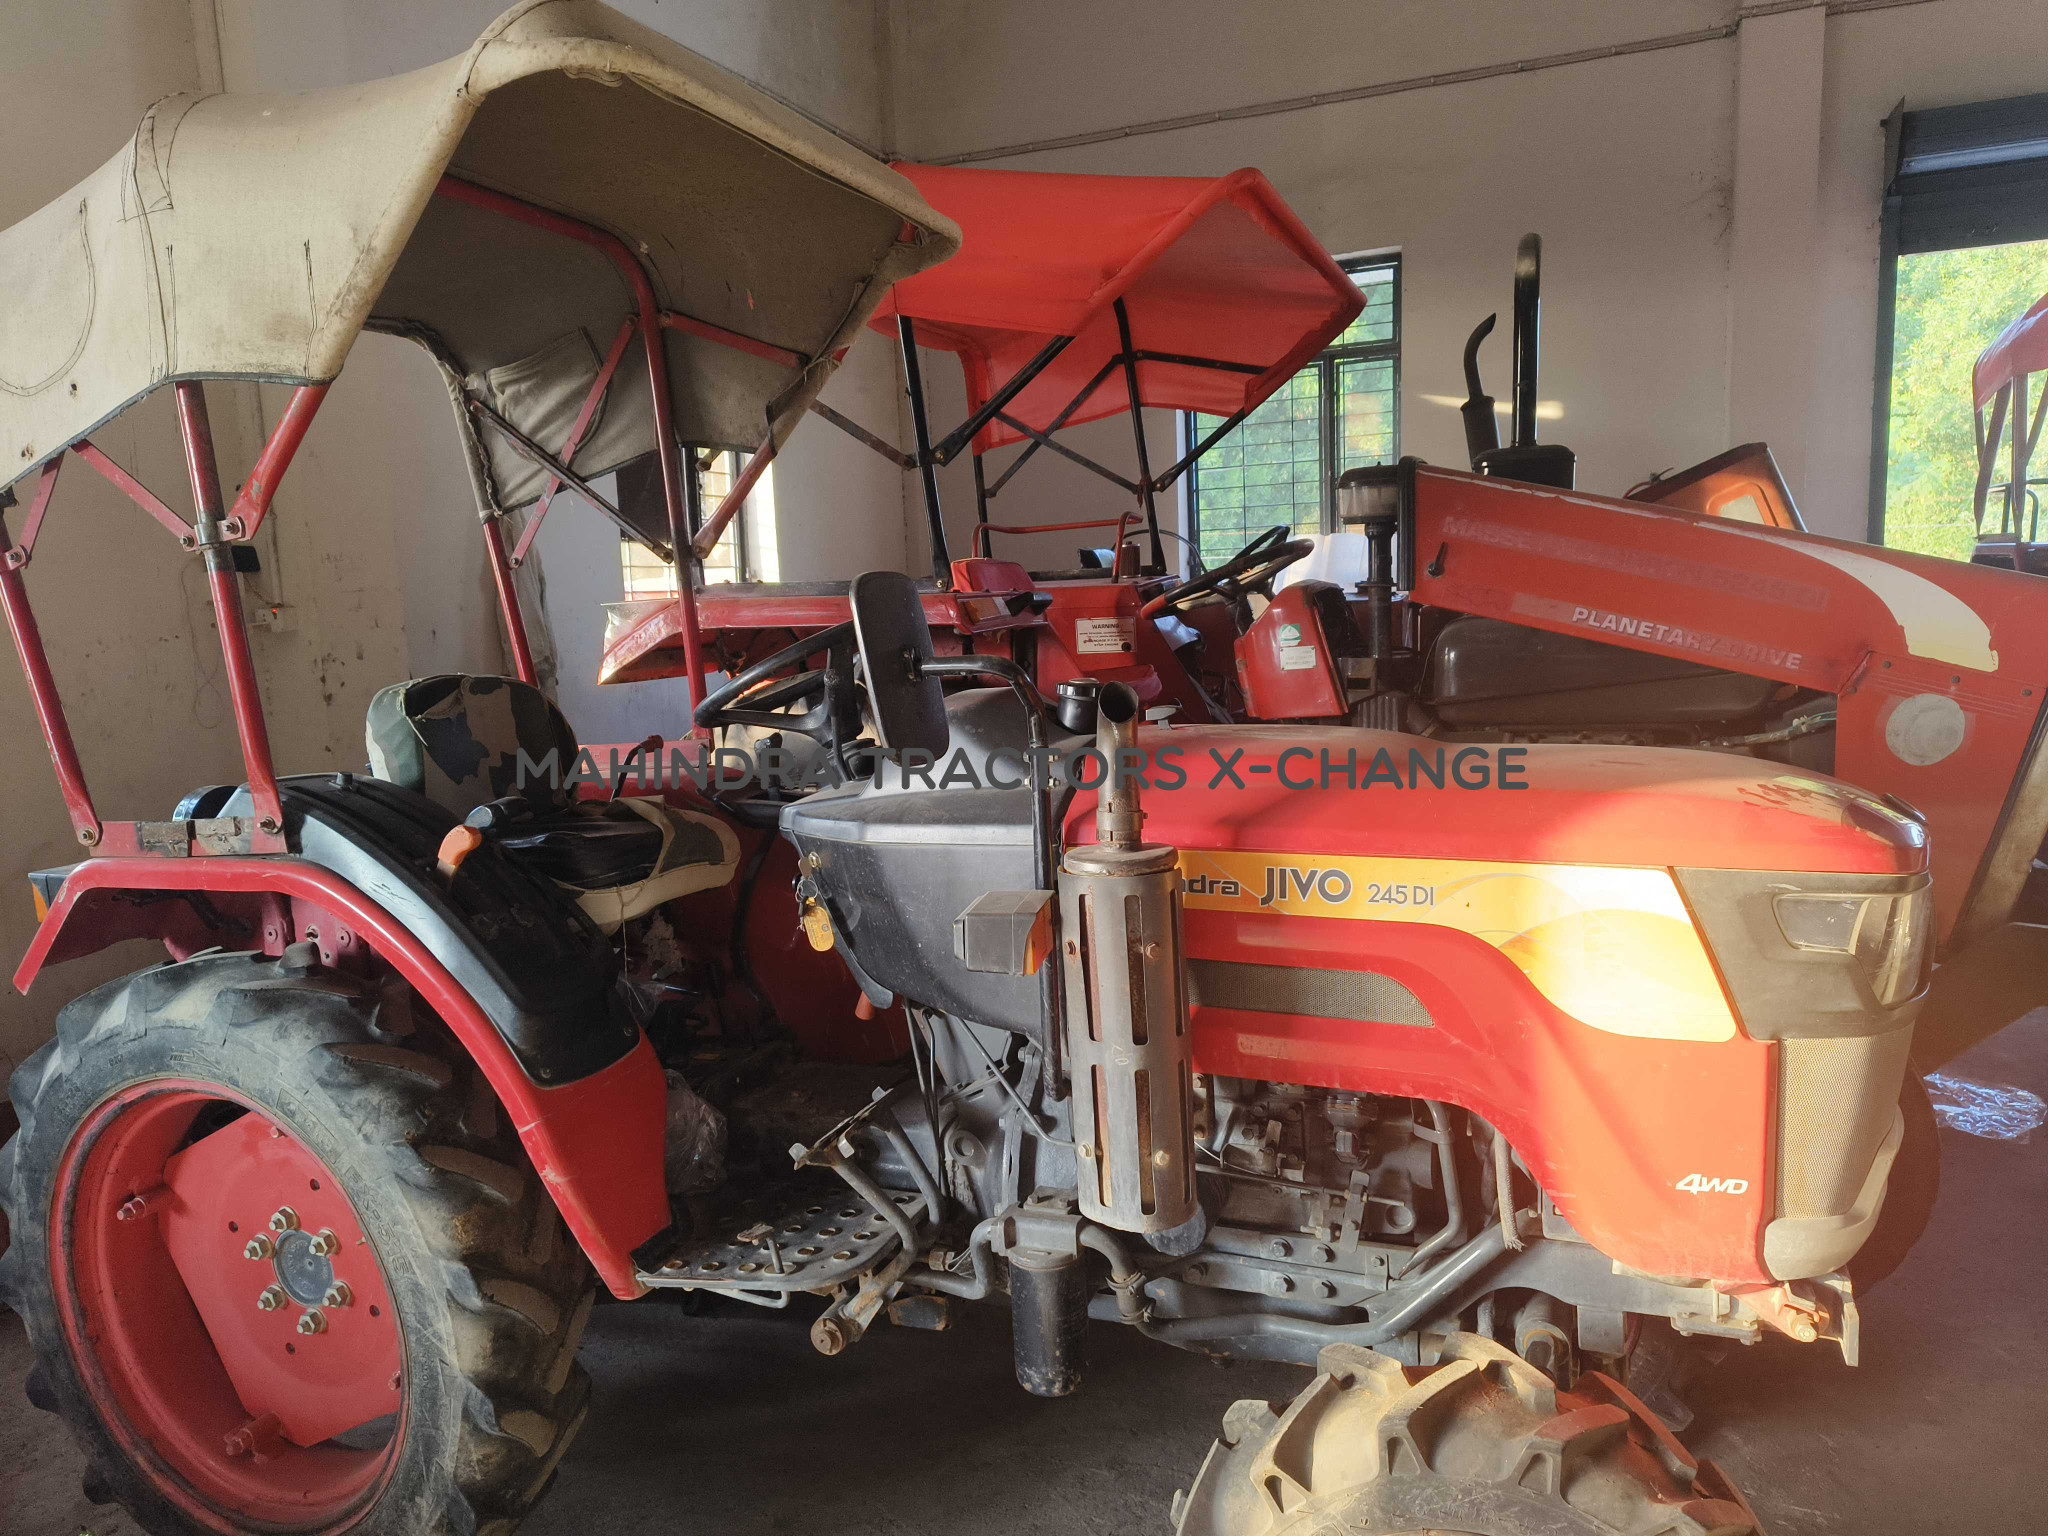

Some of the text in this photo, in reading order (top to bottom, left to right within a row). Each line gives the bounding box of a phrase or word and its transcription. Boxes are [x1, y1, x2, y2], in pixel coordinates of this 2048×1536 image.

[1572, 606, 1719, 653] PLANETARY
[1260, 867, 1352, 906] JIVO
[1367, 883, 1408, 905] 245
[1413, 885, 1434, 906] DI
[1675, 1173, 1749, 1196] 4WD
